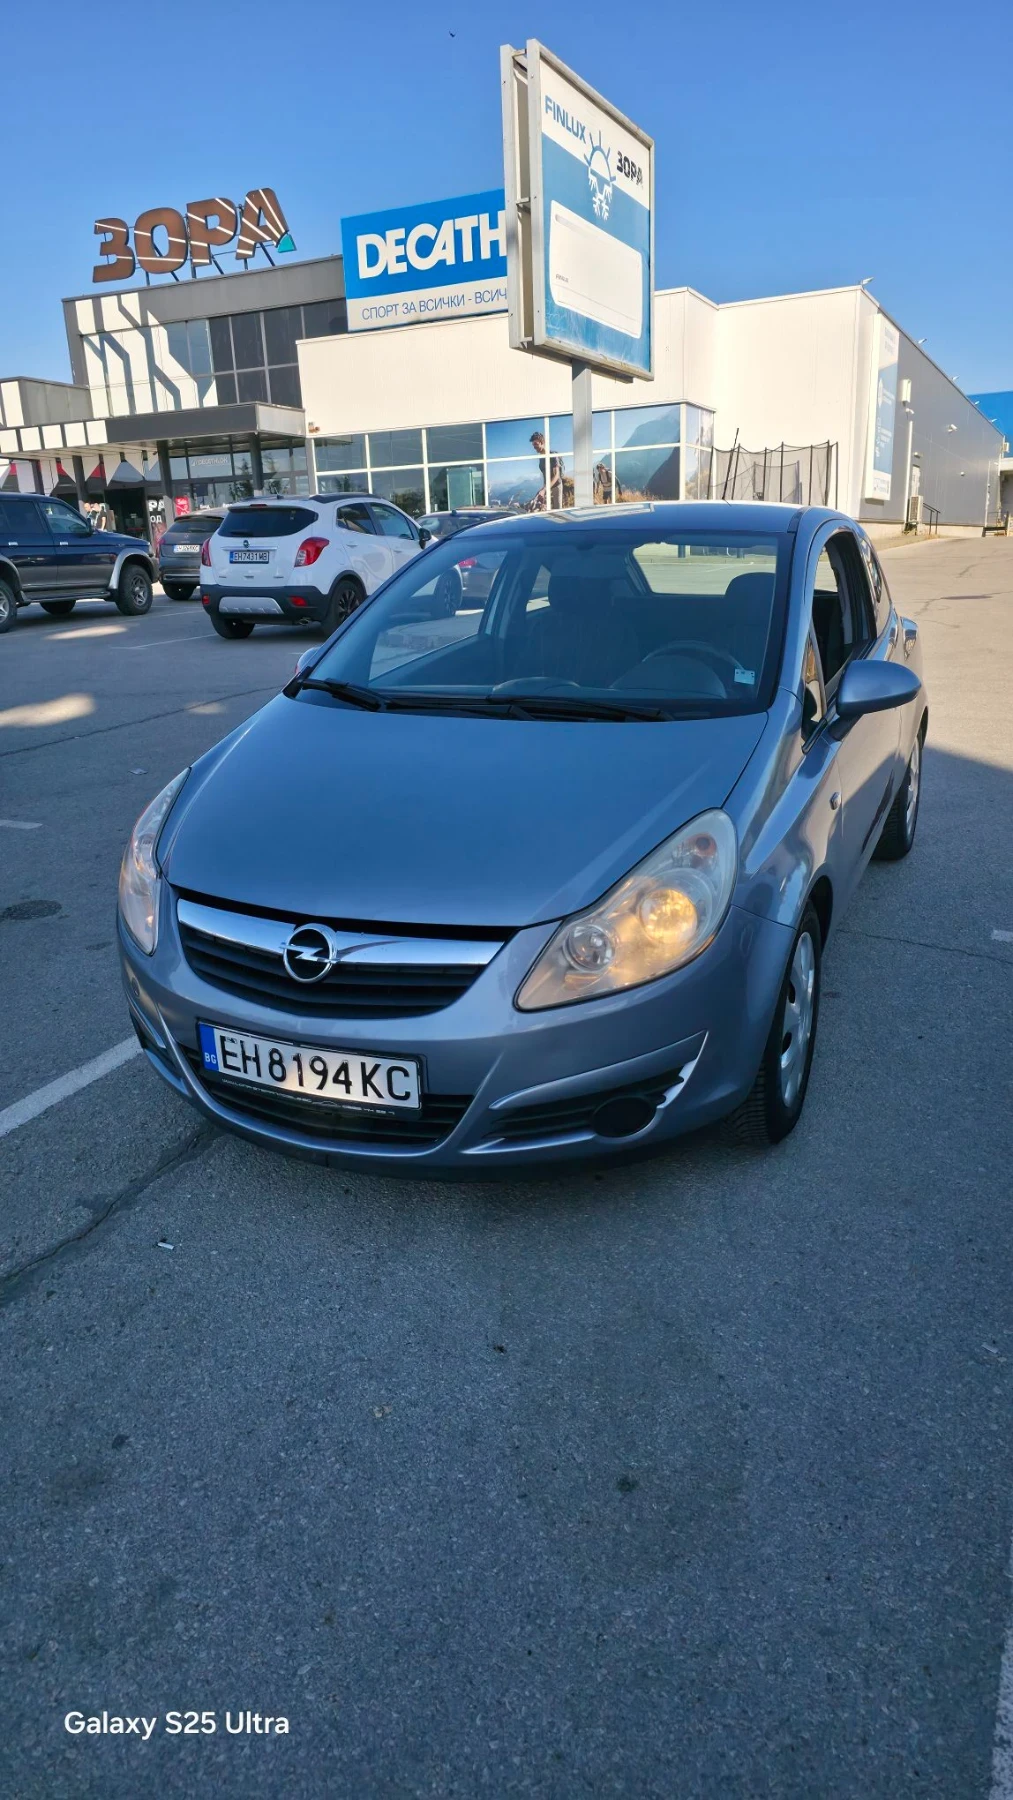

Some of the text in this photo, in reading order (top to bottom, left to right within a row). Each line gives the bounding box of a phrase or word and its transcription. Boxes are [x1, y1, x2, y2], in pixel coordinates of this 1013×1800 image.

[544, 94, 587, 145] FINLUX
[92, 187, 297, 283] ЗОРА
[362, 303, 398, 320] СПОРТ
[402, 303, 417, 315] ЗА
[419, 294, 465, 313] ВСИЧКИ
[204, 1052, 217, 1064] BG
